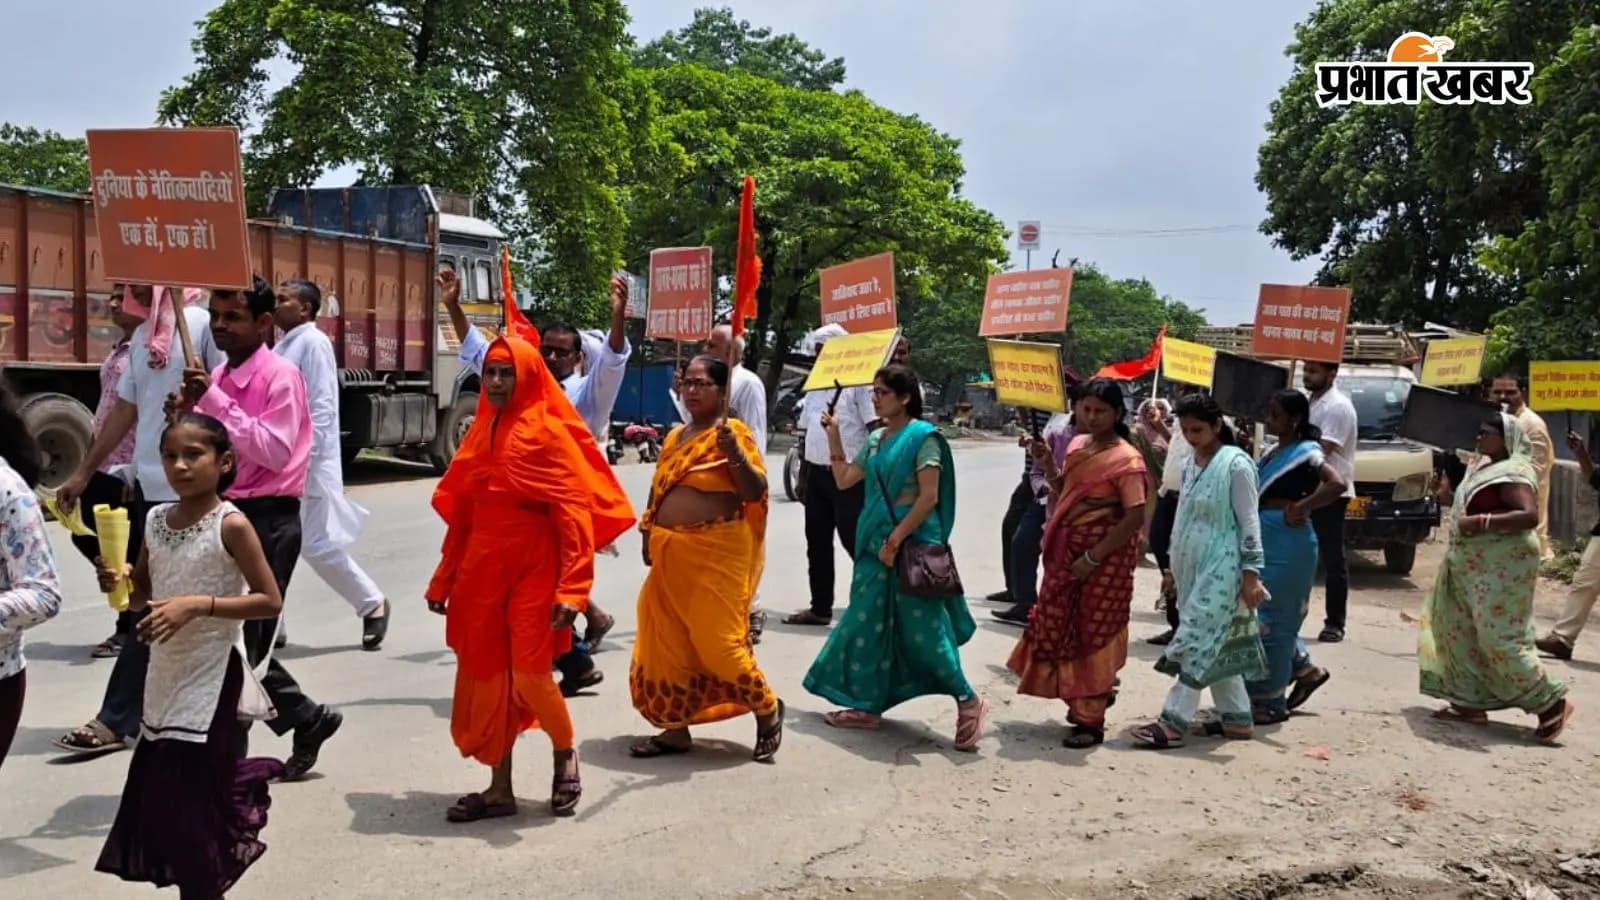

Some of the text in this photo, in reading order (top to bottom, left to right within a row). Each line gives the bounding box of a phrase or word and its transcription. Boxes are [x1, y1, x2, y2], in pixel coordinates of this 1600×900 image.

[96, 168, 233, 208] दुनिया के नैतिकवादियों
[119, 222, 142, 246] एक
[165, 223, 190, 248] एक
